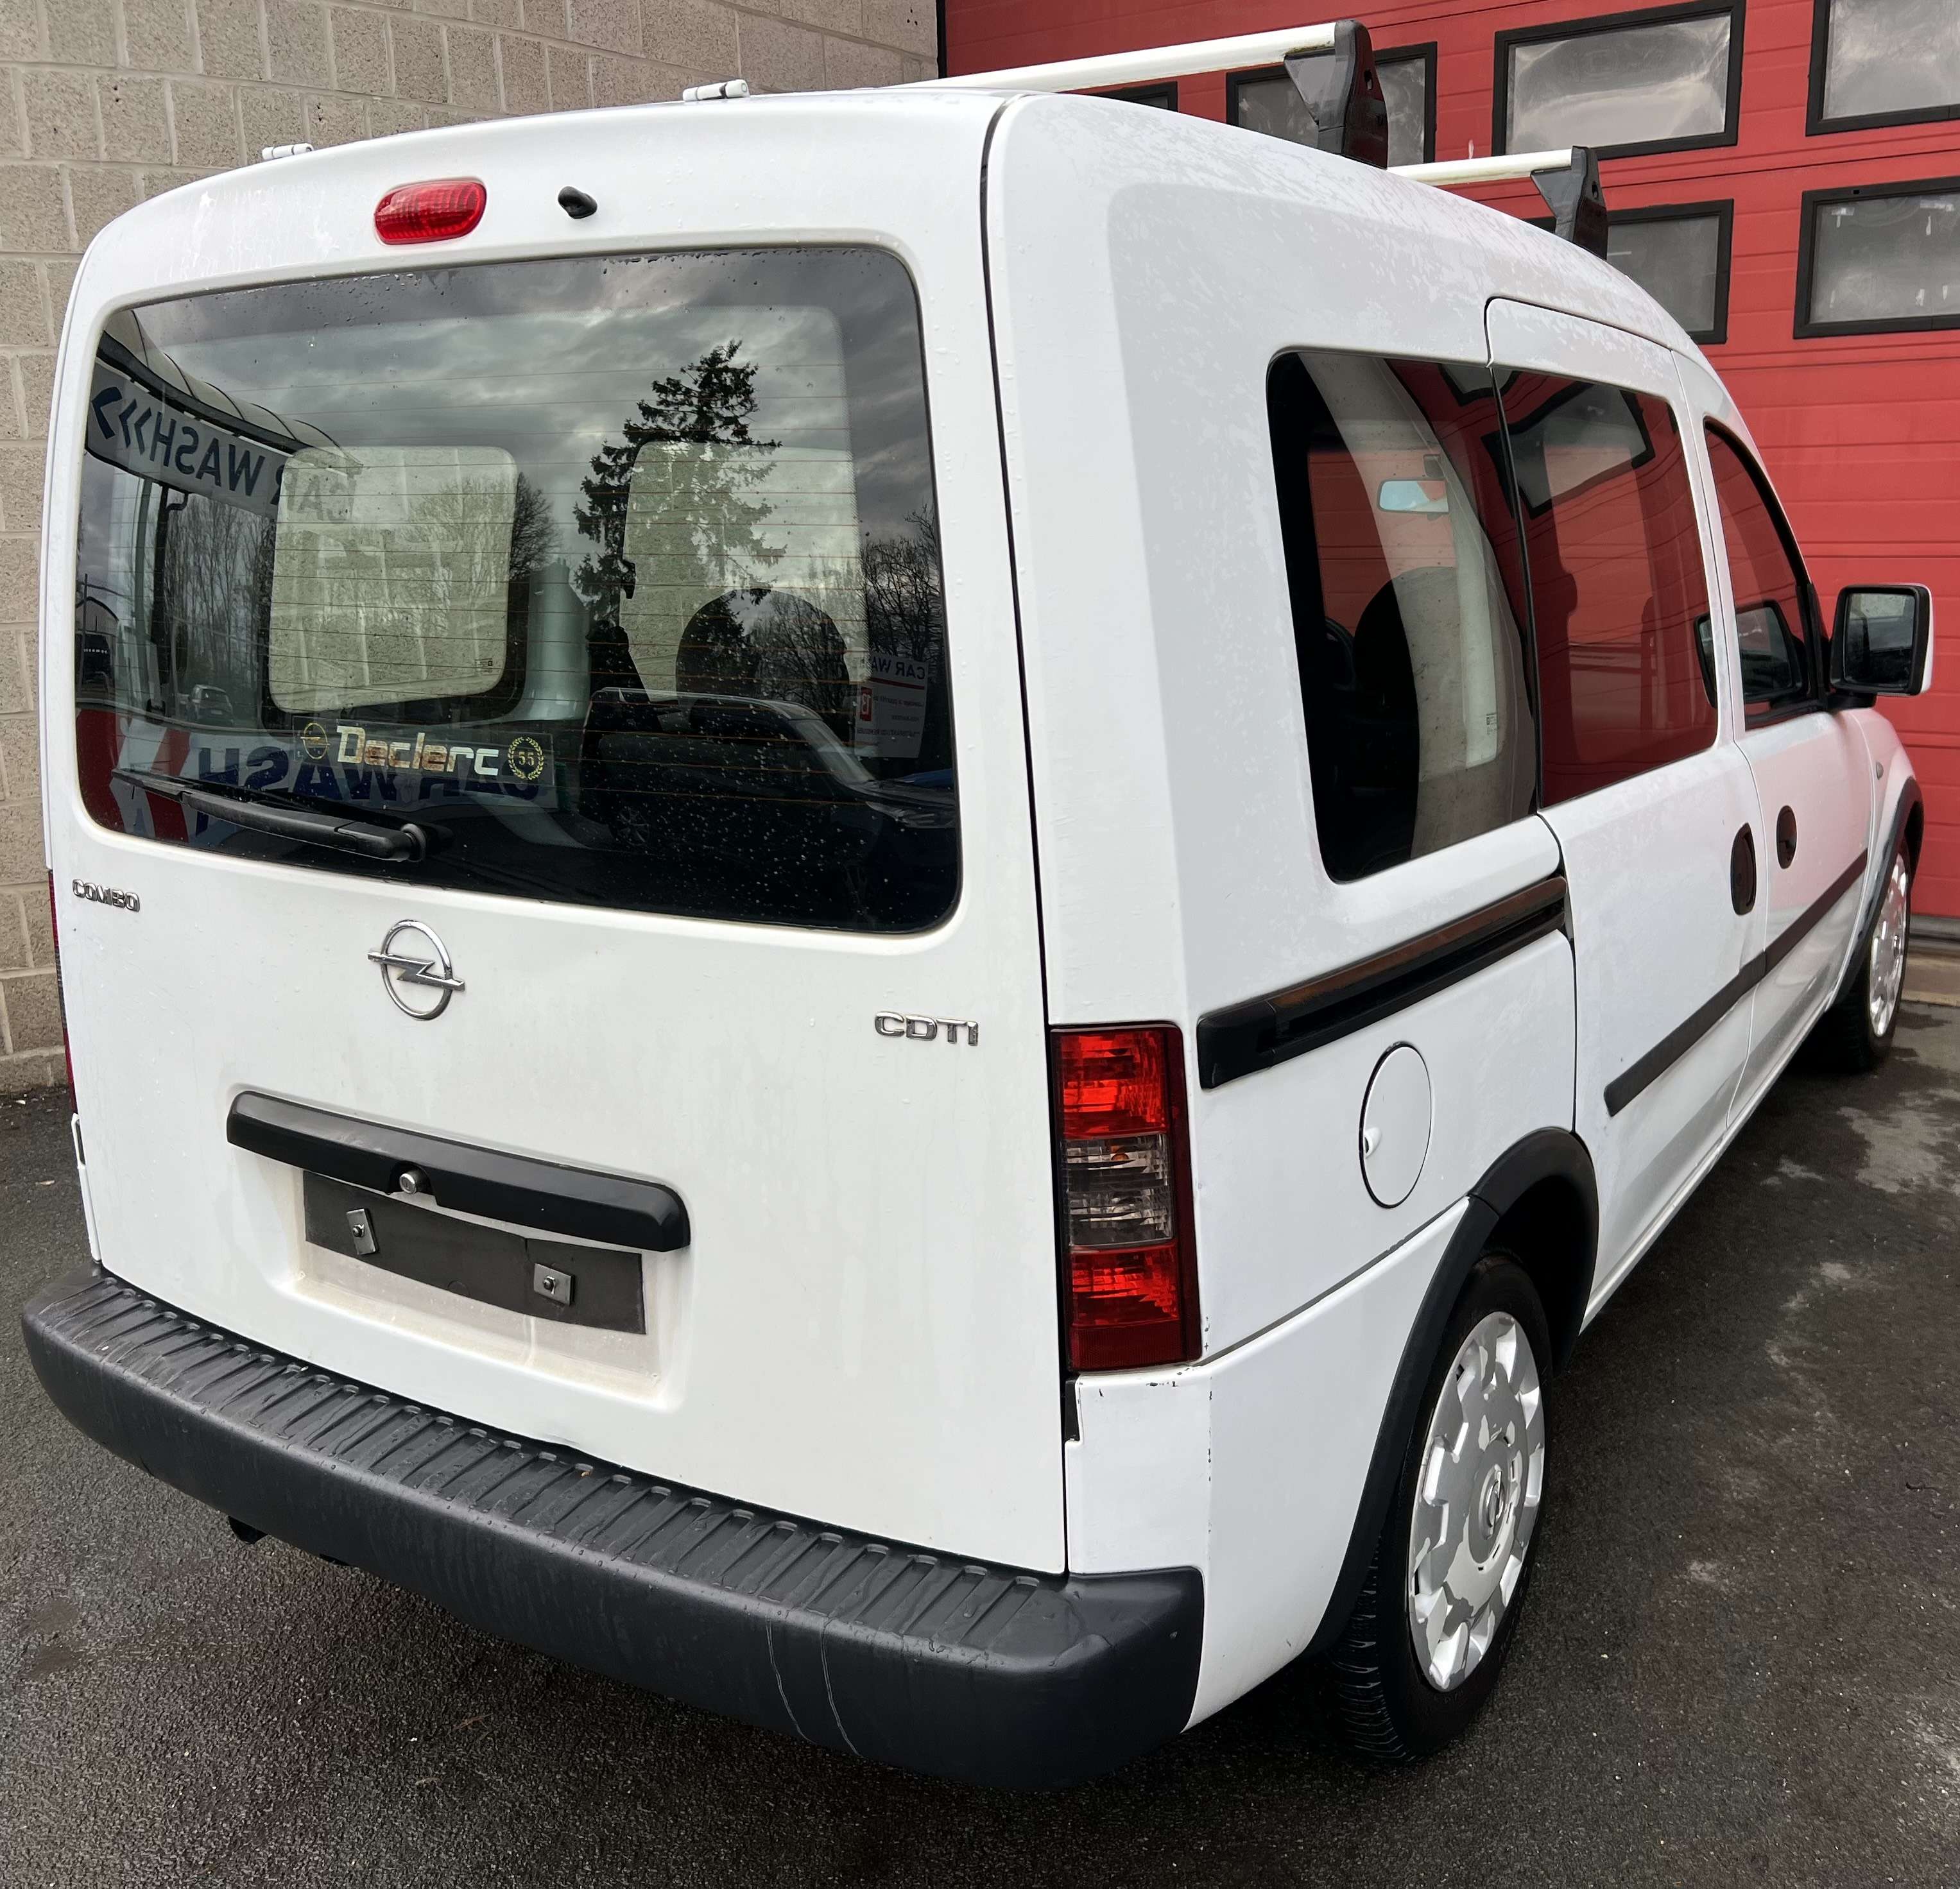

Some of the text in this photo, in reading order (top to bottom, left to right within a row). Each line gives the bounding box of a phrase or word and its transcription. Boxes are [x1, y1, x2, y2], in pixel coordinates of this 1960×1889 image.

[336, 725, 535, 776] Declerc 55
[73, 879, 140, 912] COMBO
